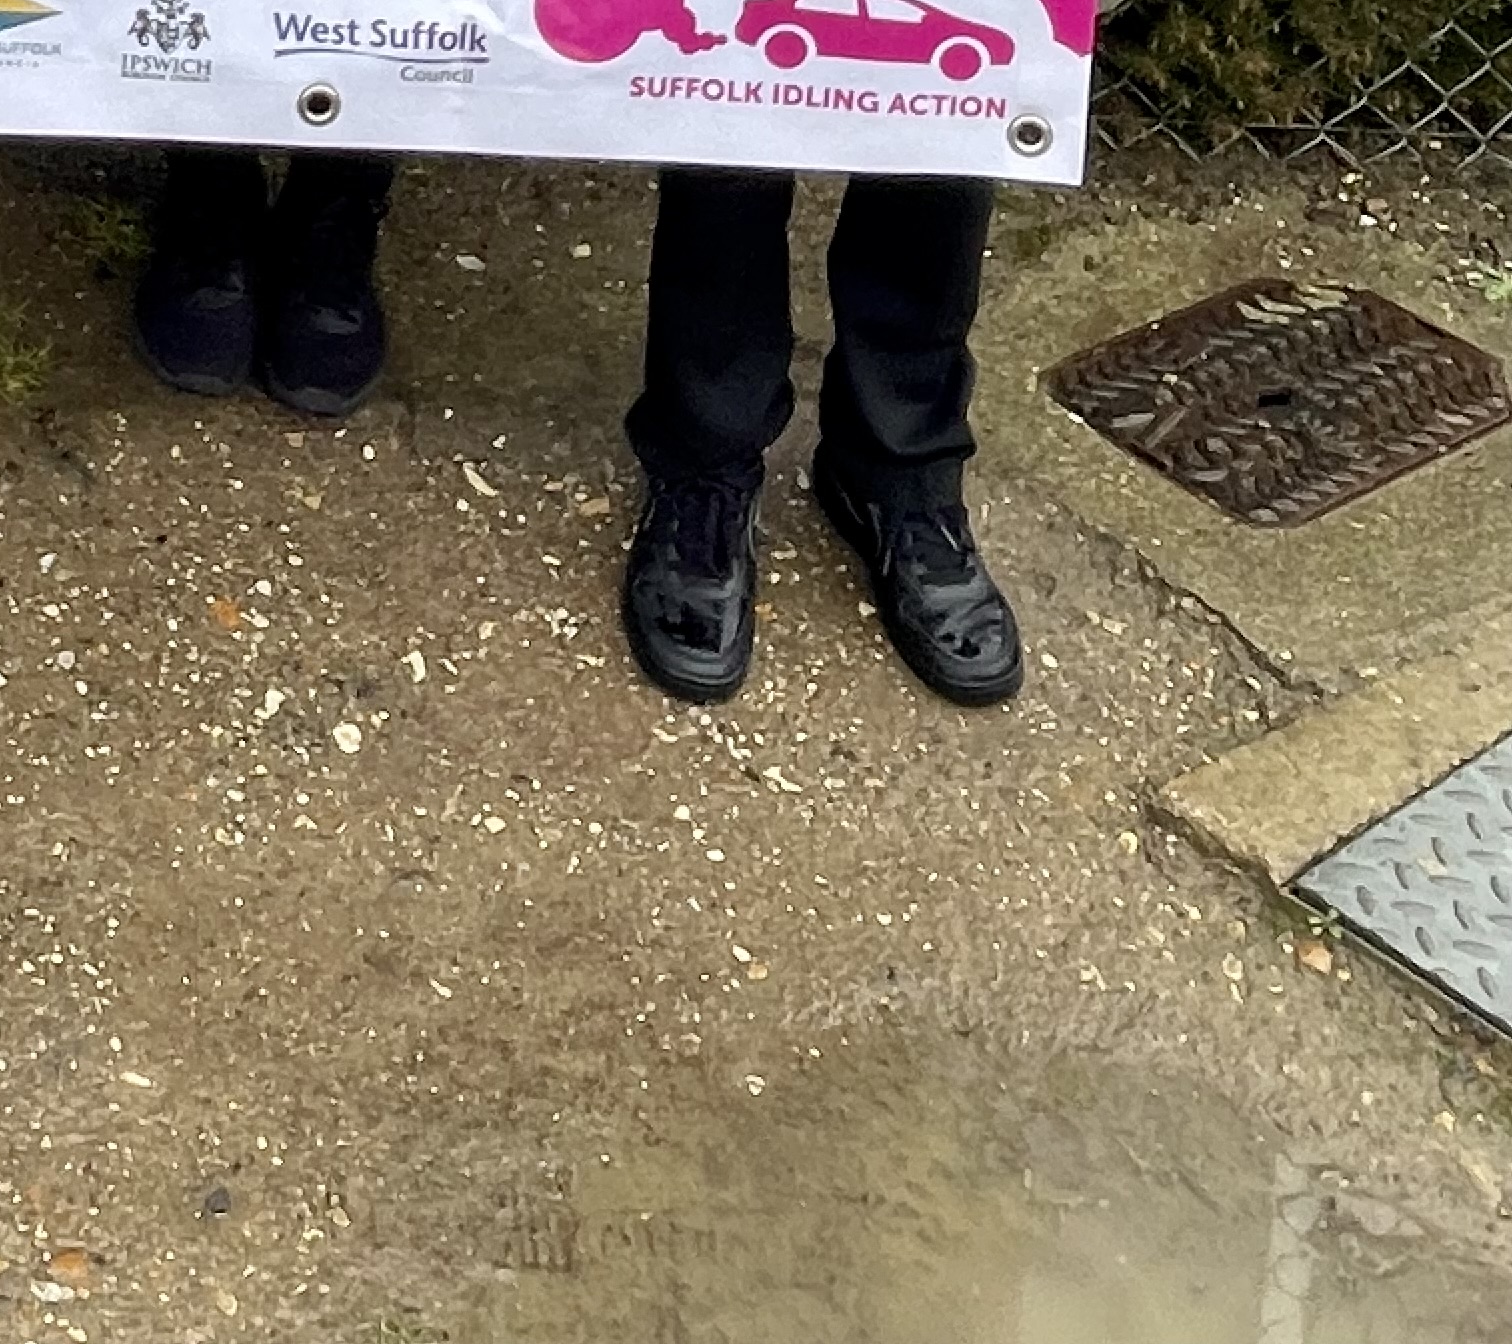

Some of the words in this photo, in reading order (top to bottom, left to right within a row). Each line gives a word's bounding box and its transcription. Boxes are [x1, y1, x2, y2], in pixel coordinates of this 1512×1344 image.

[273, 12, 360, 45] West
[369, 18, 488, 53] Suffolk
[120, 52, 212, 75] IPSWICH
[400, 65, 473, 84] Council
[629, 75, 762, 104] SUFFOLK
[772, 82, 879, 113] IDLING
[887, 92, 1006, 119] ACTION
